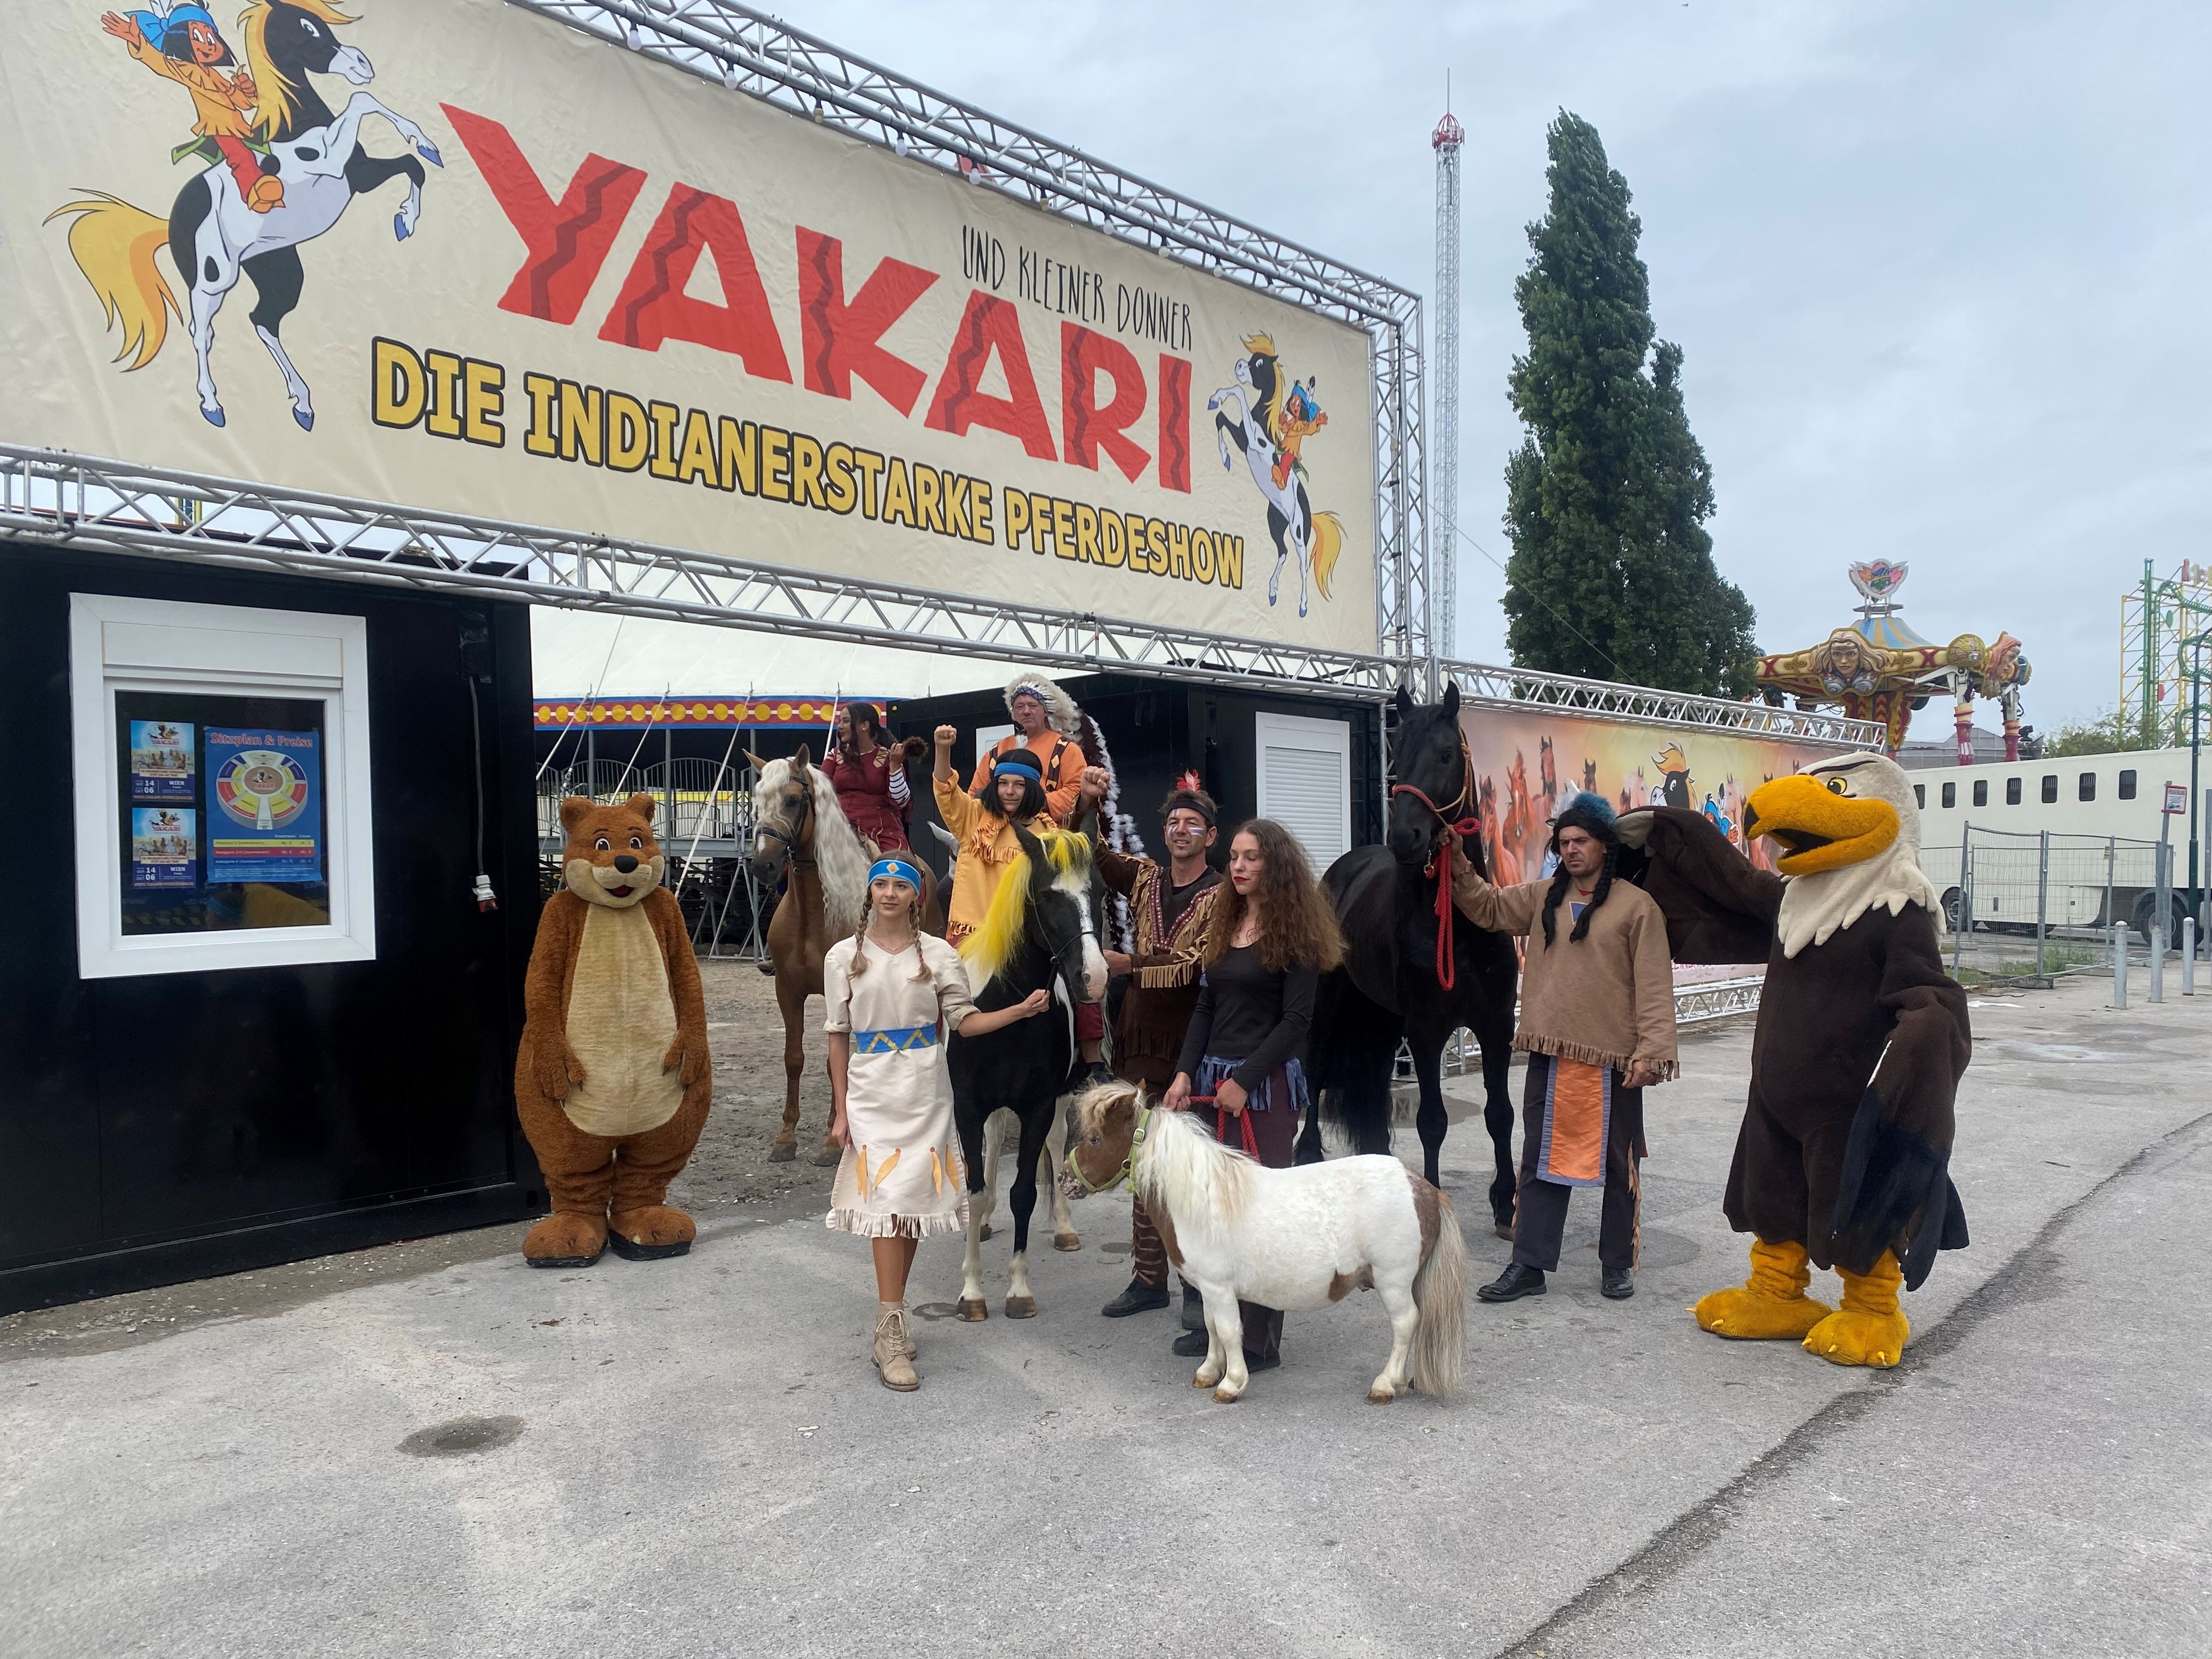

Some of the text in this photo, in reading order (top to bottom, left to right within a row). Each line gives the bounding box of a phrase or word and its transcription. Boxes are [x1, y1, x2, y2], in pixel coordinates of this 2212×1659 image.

[440, 103, 1192, 494] YAKARI
[962, 224, 1192, 352] UND KLEINER DONNER
[372, 336, 1244, 590] DIE INDIANERSTARKE PFERDESHOW
[211, 732, 313, 748] Sitzplan & Preise
